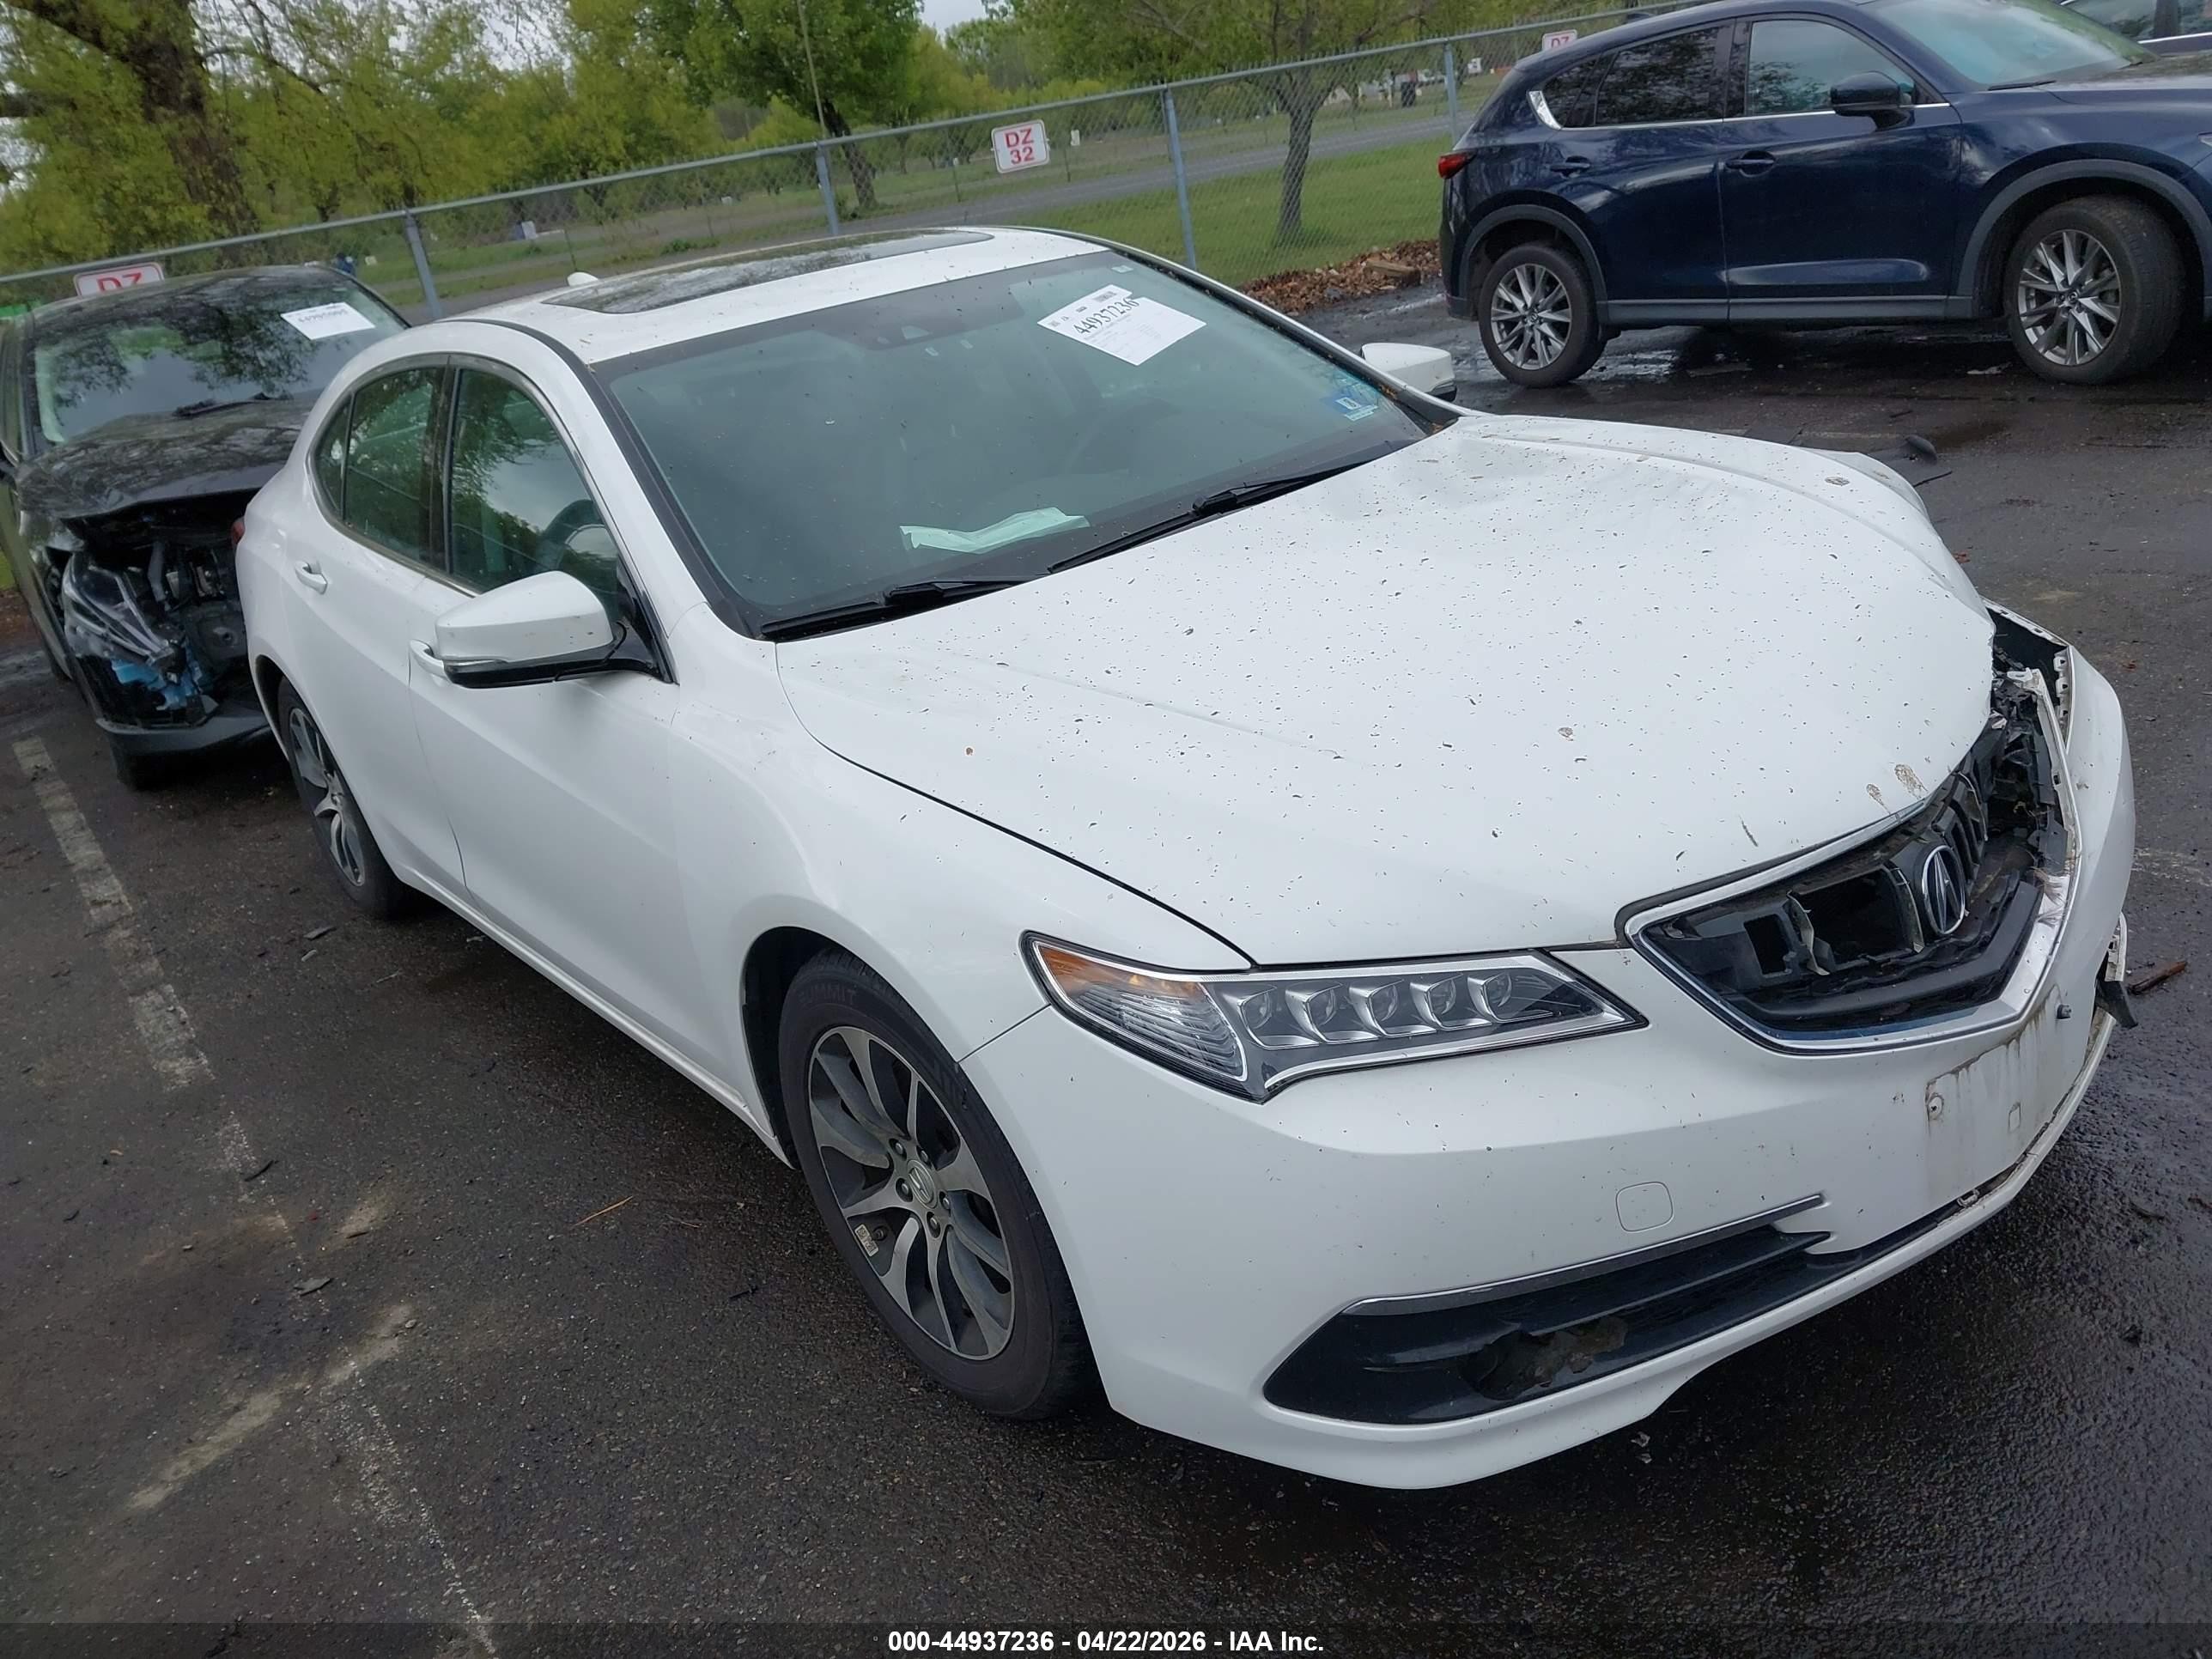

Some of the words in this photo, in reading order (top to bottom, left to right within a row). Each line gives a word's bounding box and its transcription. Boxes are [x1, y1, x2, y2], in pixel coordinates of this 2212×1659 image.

[1005, 128, 1034, 148] DZ
[1010, 146, 1035, 164] 32
[1073, 297, 1139, 334] 44937236
